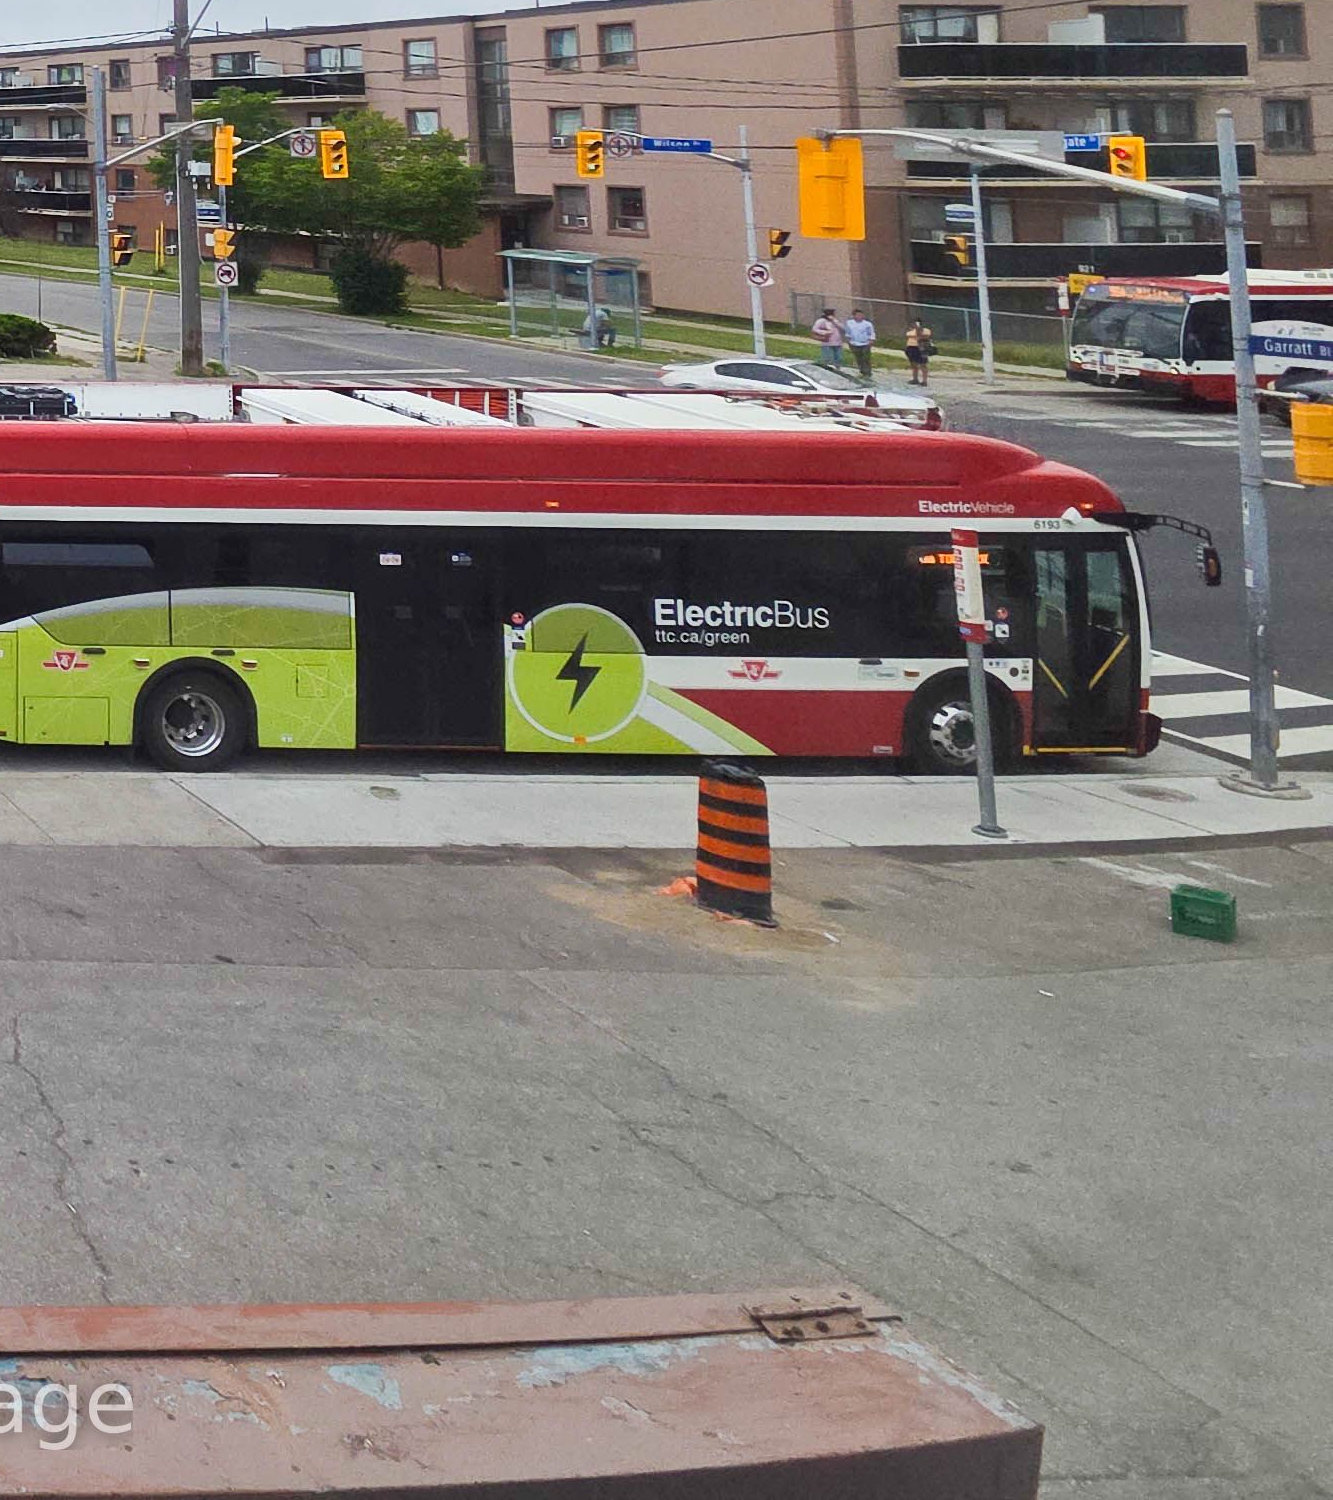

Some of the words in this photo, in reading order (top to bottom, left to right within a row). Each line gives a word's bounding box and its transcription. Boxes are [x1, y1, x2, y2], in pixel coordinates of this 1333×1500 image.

[1263, 338, 1313, 356] Garratt
[1033, 520, 1061, 530] 6193
[655, 629, 750, 647] ttc.ca/green
